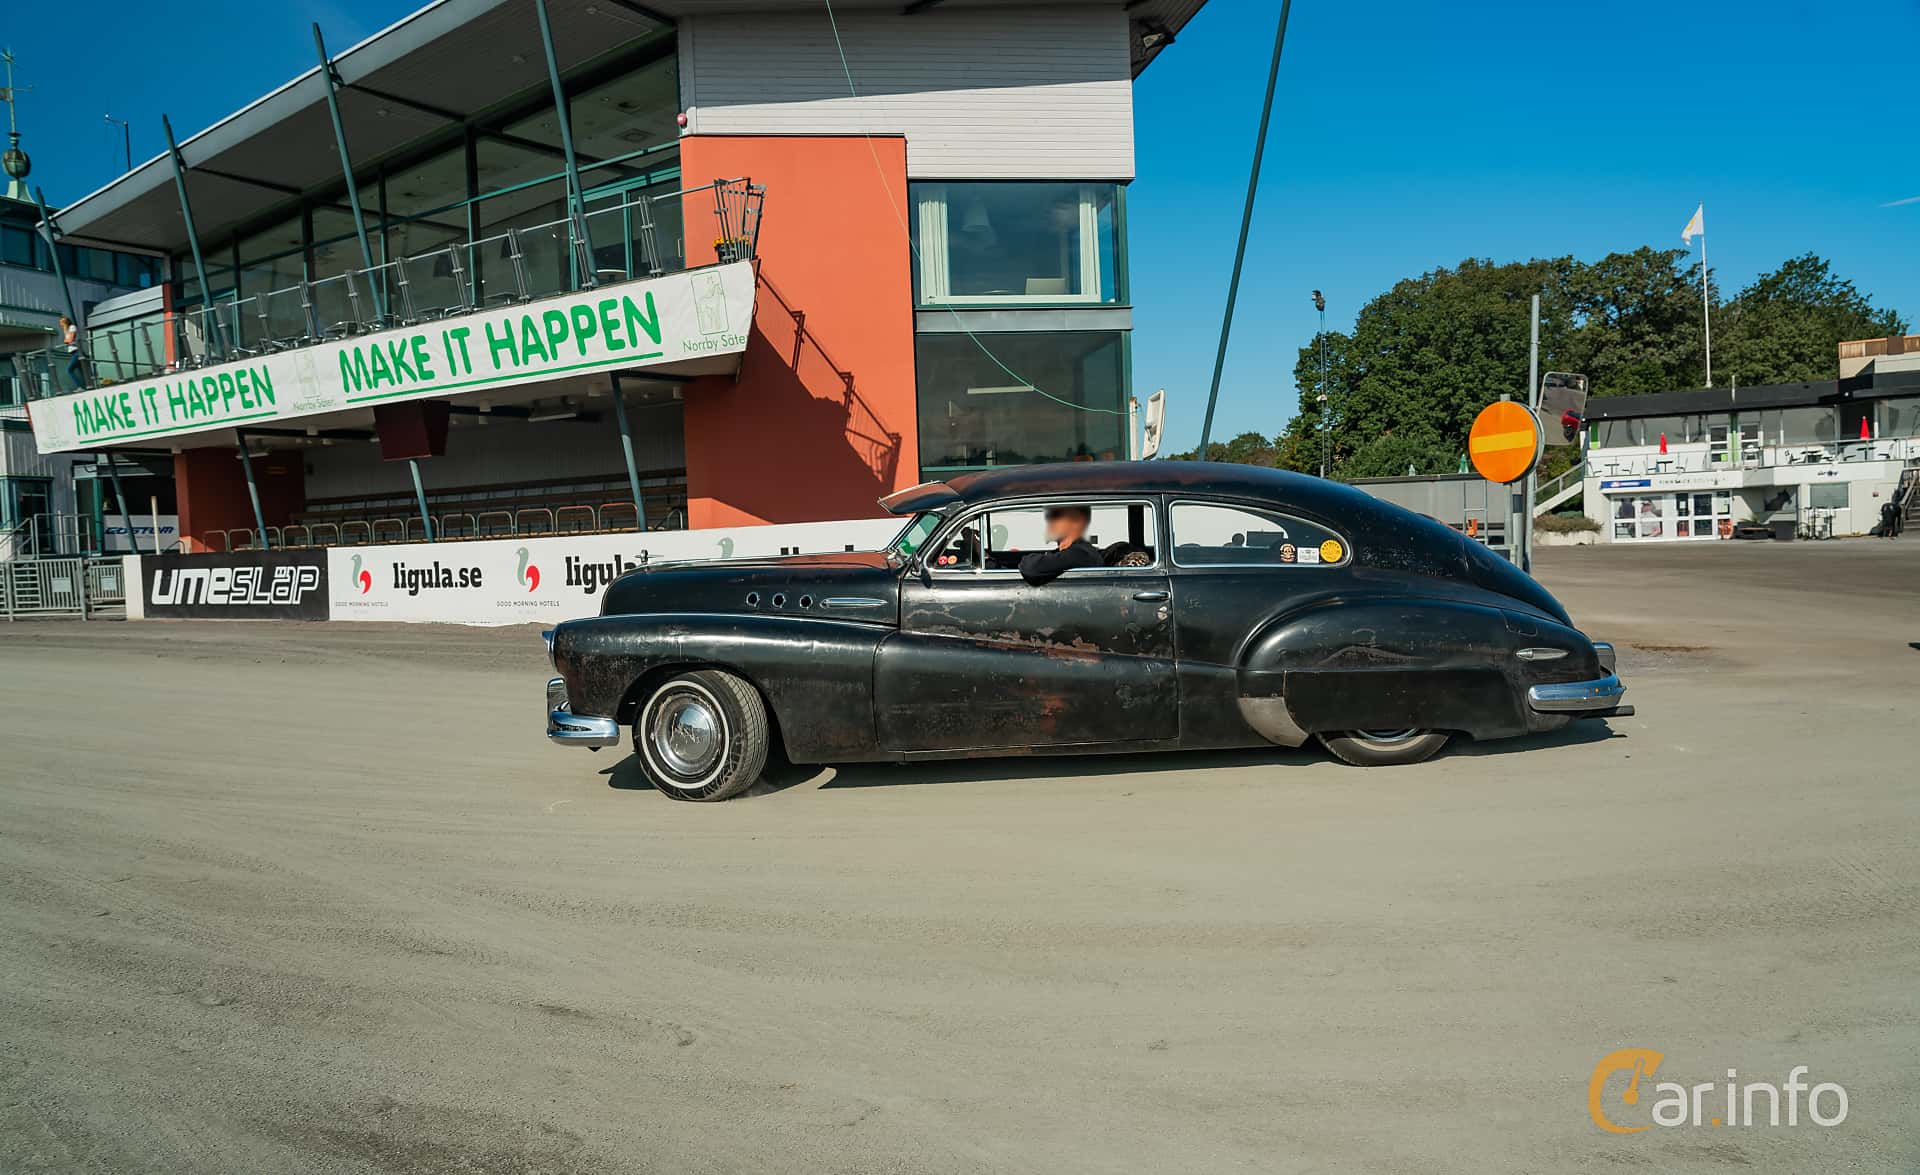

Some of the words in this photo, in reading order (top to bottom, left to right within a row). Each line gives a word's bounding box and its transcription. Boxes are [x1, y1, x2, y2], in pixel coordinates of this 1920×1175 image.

[338, 336, 436, 394] MAKE
[442, 326, 473, 377] IT
[485, 290, 663, 370] HAPPEN
[682, 336, 719, 353] Norrby
[73, 392, 137, 437] MAKE
[139, 386, 158, 425] IT
[166, 365, 277, 422] HAPPEN
[392, 562, 482, 597] ligula.se
